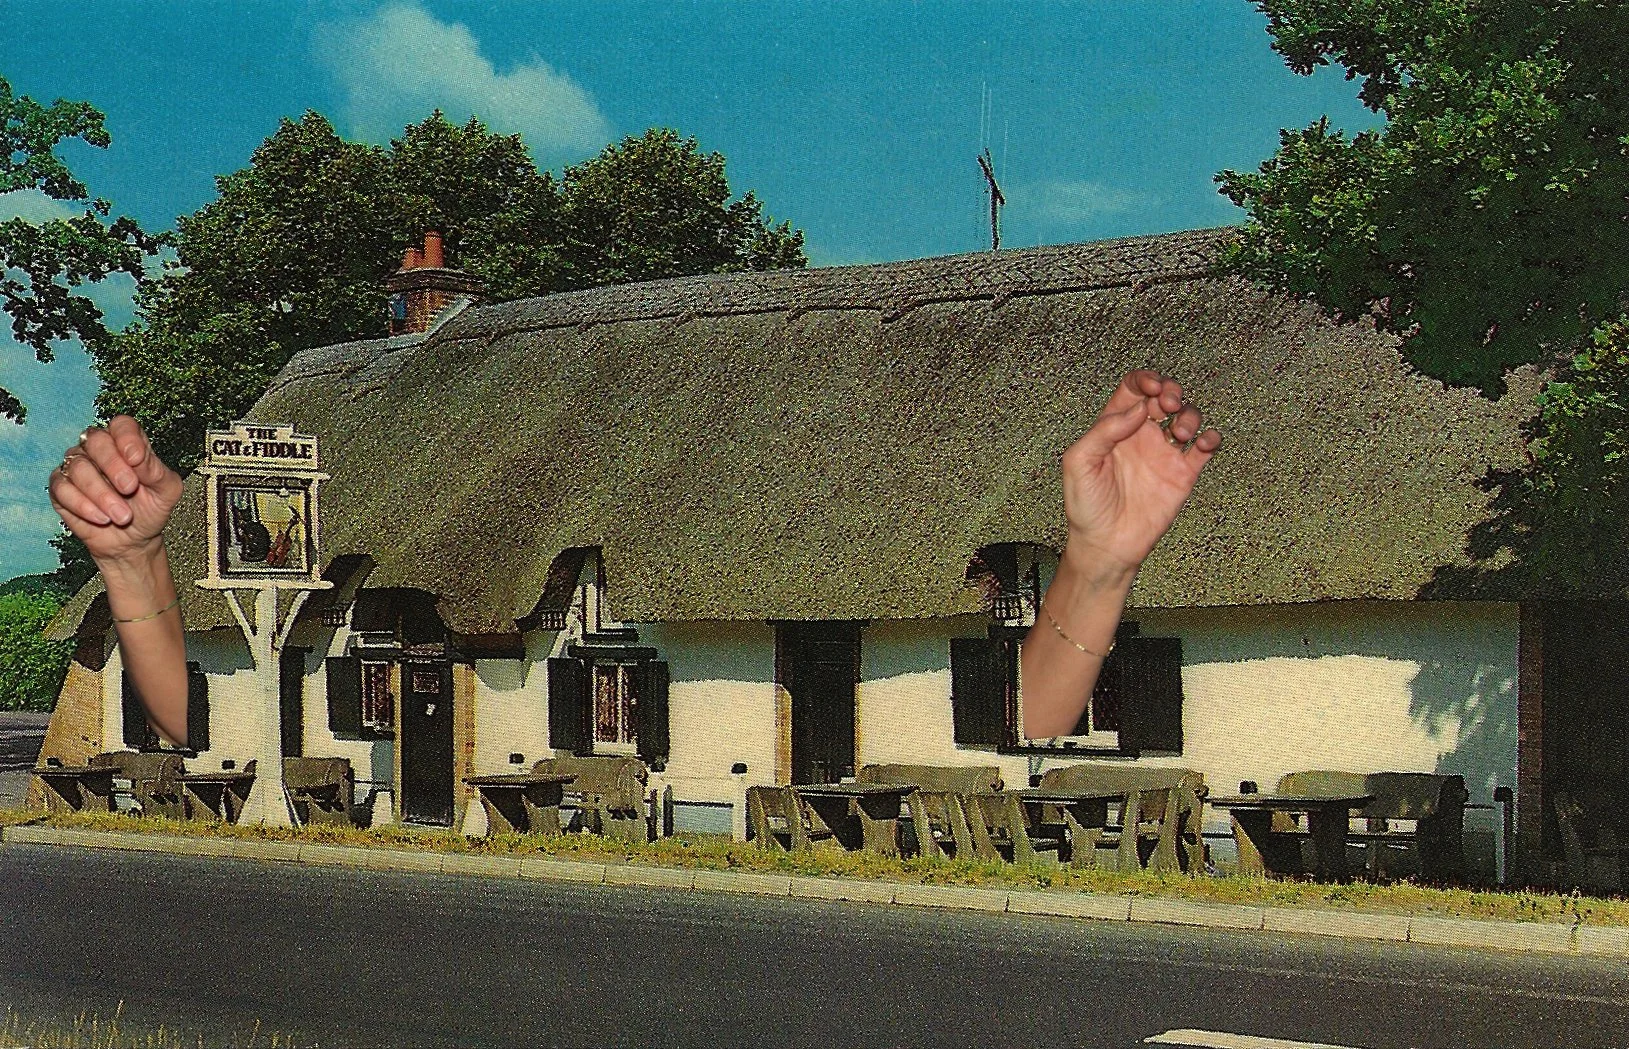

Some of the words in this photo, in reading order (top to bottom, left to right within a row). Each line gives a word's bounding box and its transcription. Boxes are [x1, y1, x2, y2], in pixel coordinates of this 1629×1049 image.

[245, 427, 278, 441] THE
[212, 439, 242, 456] CAT
[252, 441, 313, 459] FIDDLE
